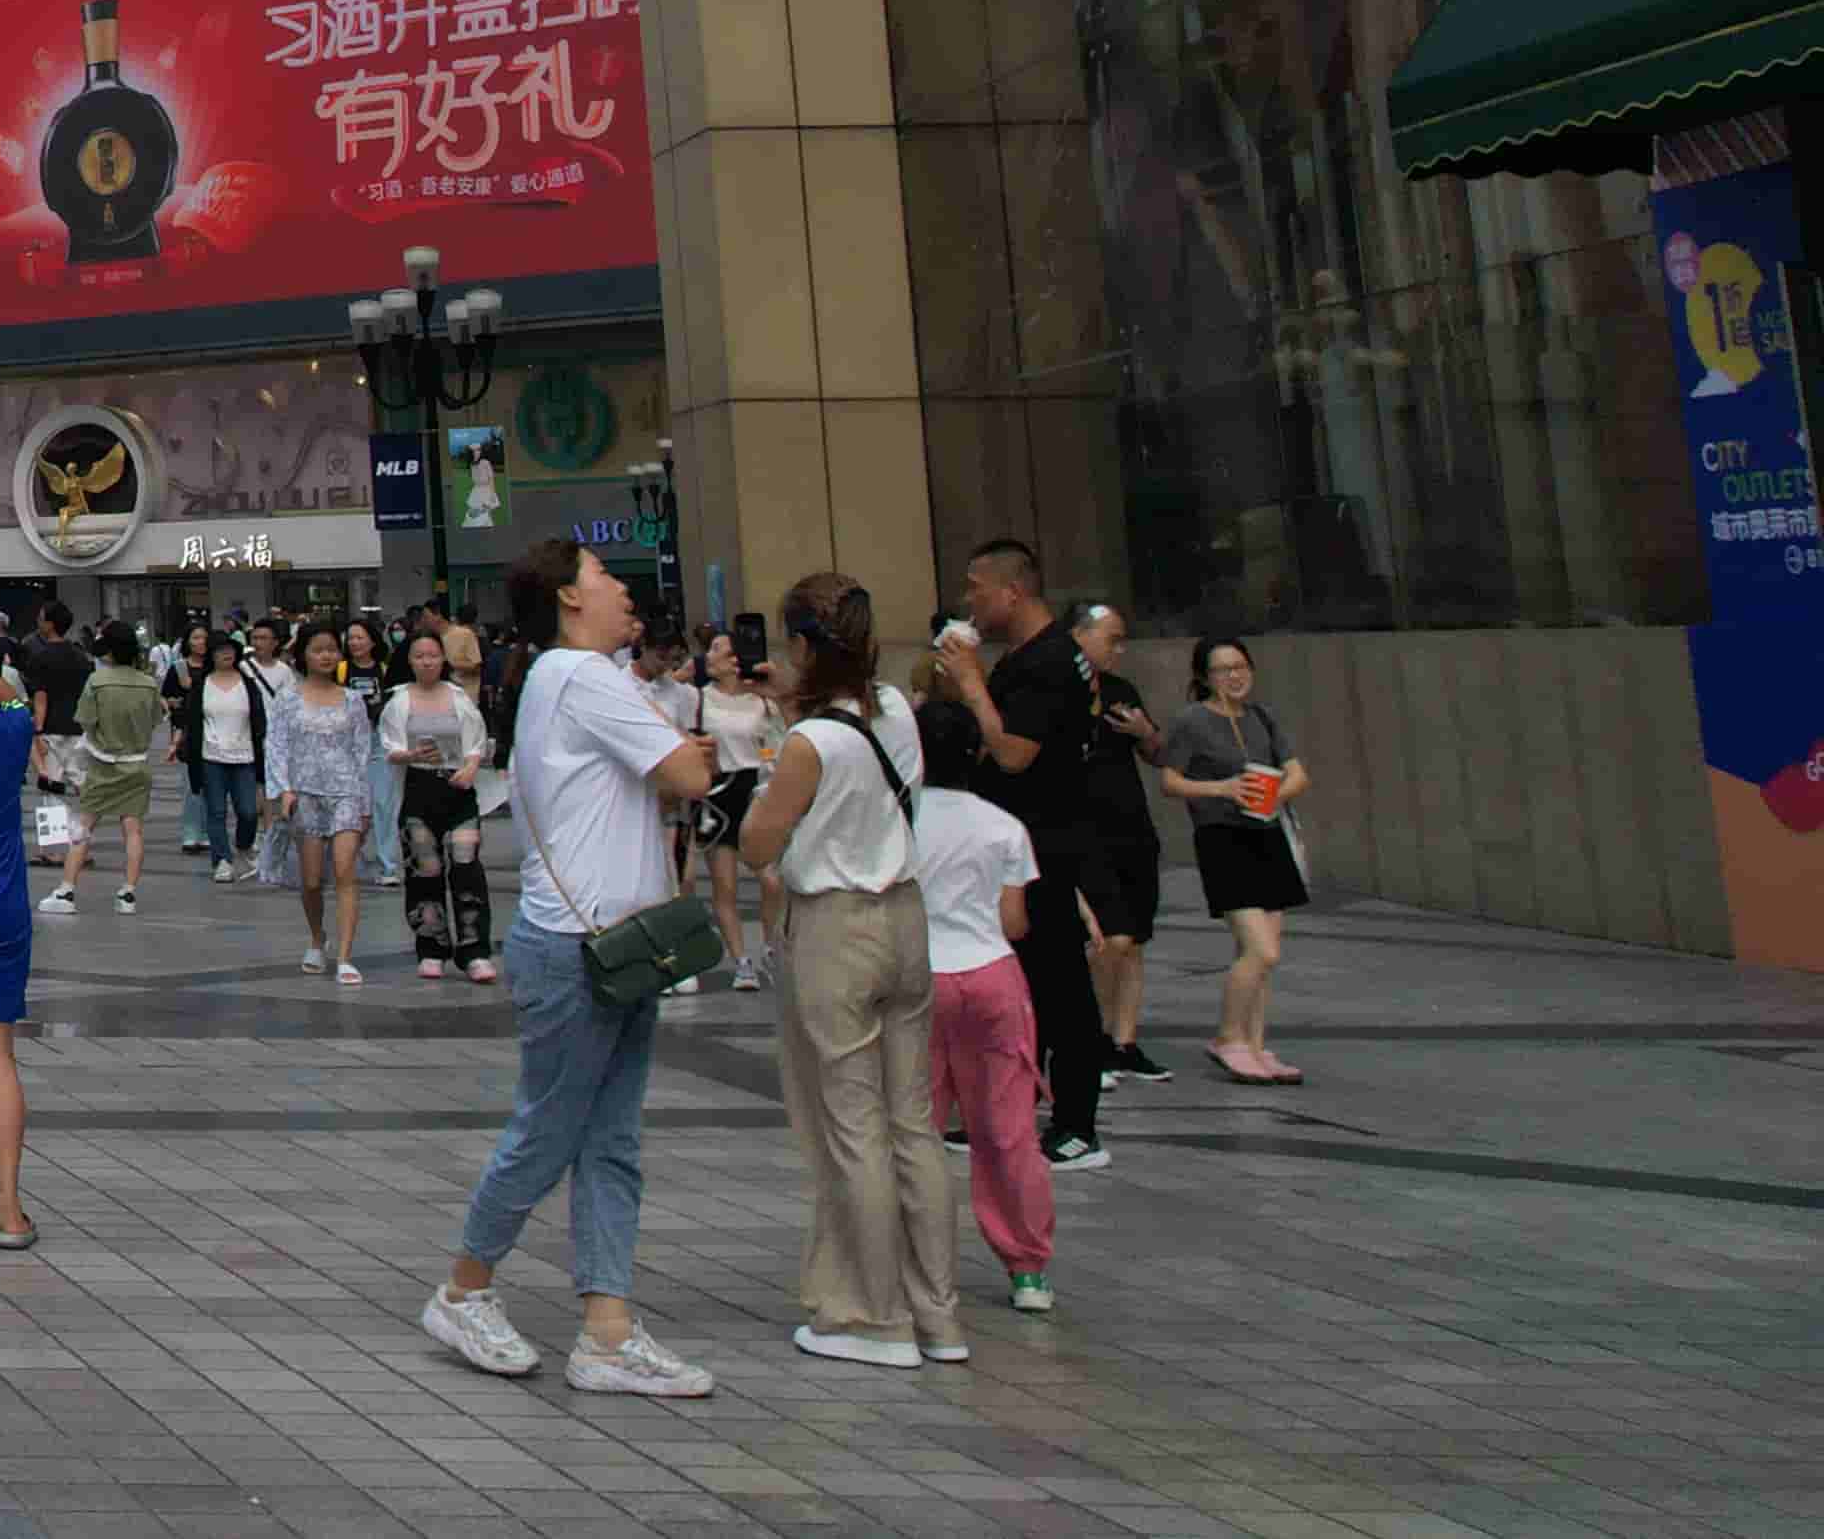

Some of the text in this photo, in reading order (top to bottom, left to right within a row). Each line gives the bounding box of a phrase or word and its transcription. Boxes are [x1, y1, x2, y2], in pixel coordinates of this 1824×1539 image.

[316, 38, 616, 180] 有好礼
[374, 459, 420, 476] MLB
[1701, 439, 1749, 472] CITY
[179, 534, 273, 570] 周六福
